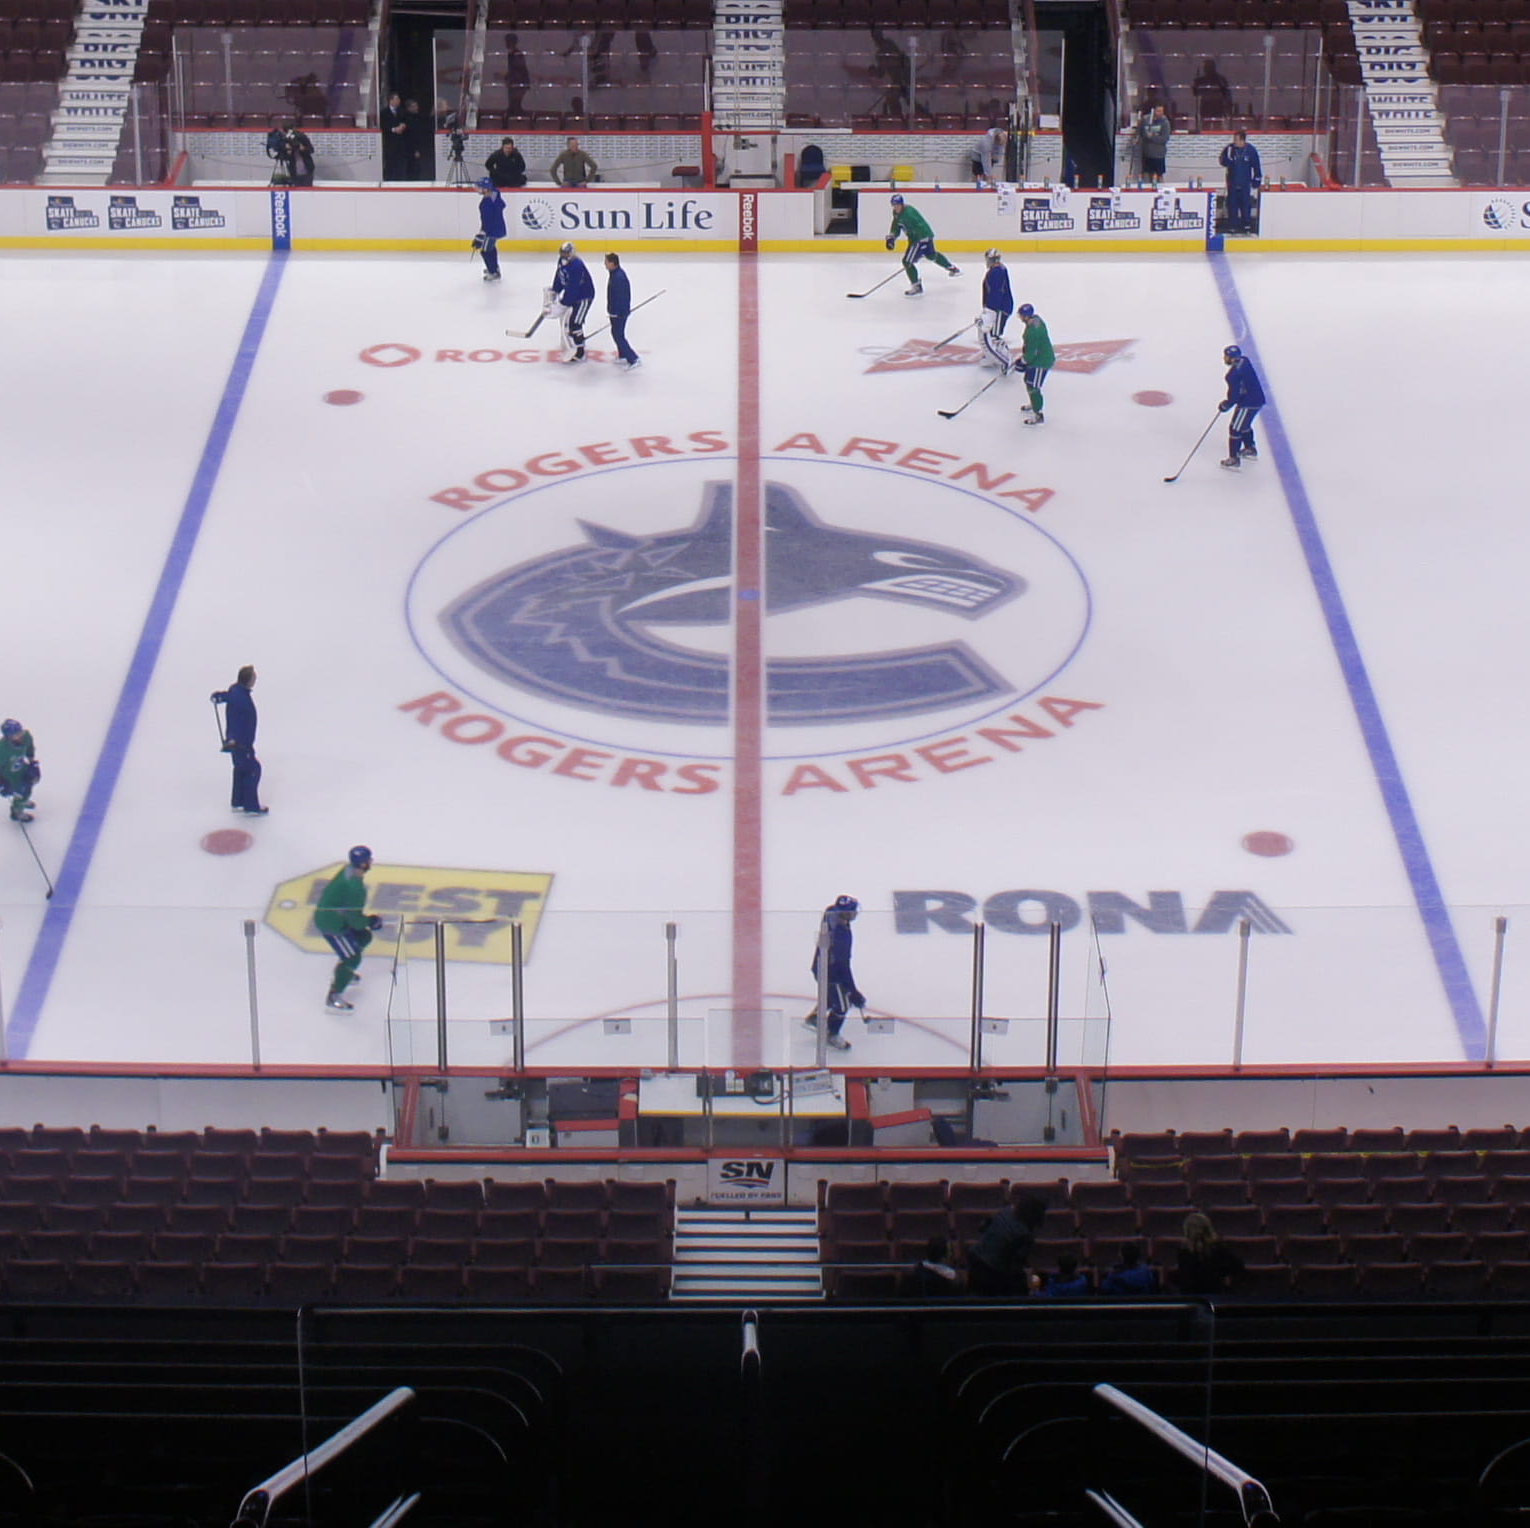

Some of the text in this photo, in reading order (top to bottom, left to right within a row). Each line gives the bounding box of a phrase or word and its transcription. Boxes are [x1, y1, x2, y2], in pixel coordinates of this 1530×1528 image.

[274, 191, 287, 239] Reebok
[560, 200, 714, 230] Sun Life
[743, 193, 755, 241] Reebok
[429, 429, 1058, 513] ROGERS ARENA
[397, 690, 1106, 796] ROGERS ARENA
[305, 912, 515, 948] UY
[893, 889, 1295, 936] RONA
[720, 1160, 775, 1180] SN
